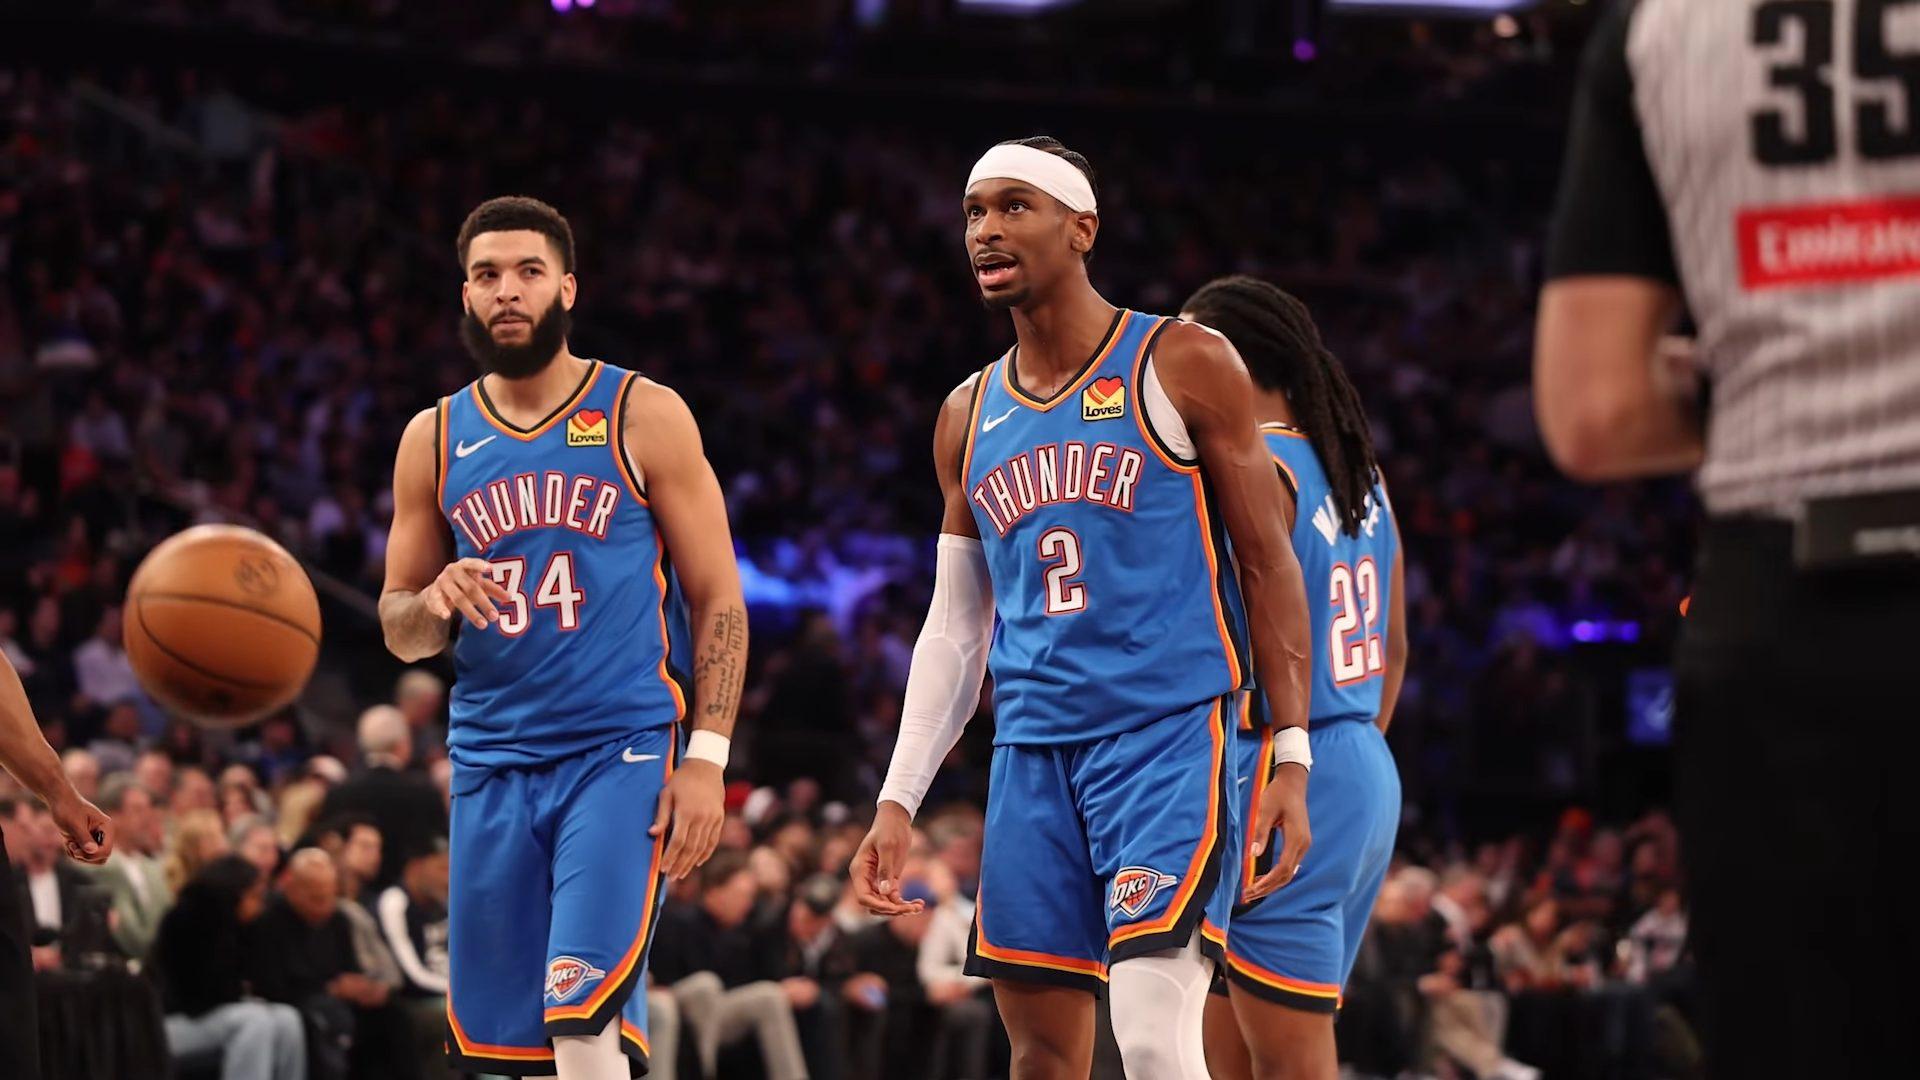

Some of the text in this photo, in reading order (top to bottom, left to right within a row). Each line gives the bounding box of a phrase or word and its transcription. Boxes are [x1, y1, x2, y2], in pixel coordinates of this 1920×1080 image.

[1752, 0, 1920, 166] 35
[452, 471, 619, 552] THUNDER
[973, 443, 1144, 537] THUNDER
[489, 553, 583, 635] 34
[1038, 527, 1087, 615] 2
[1330, 556, 1384, 685] 22
